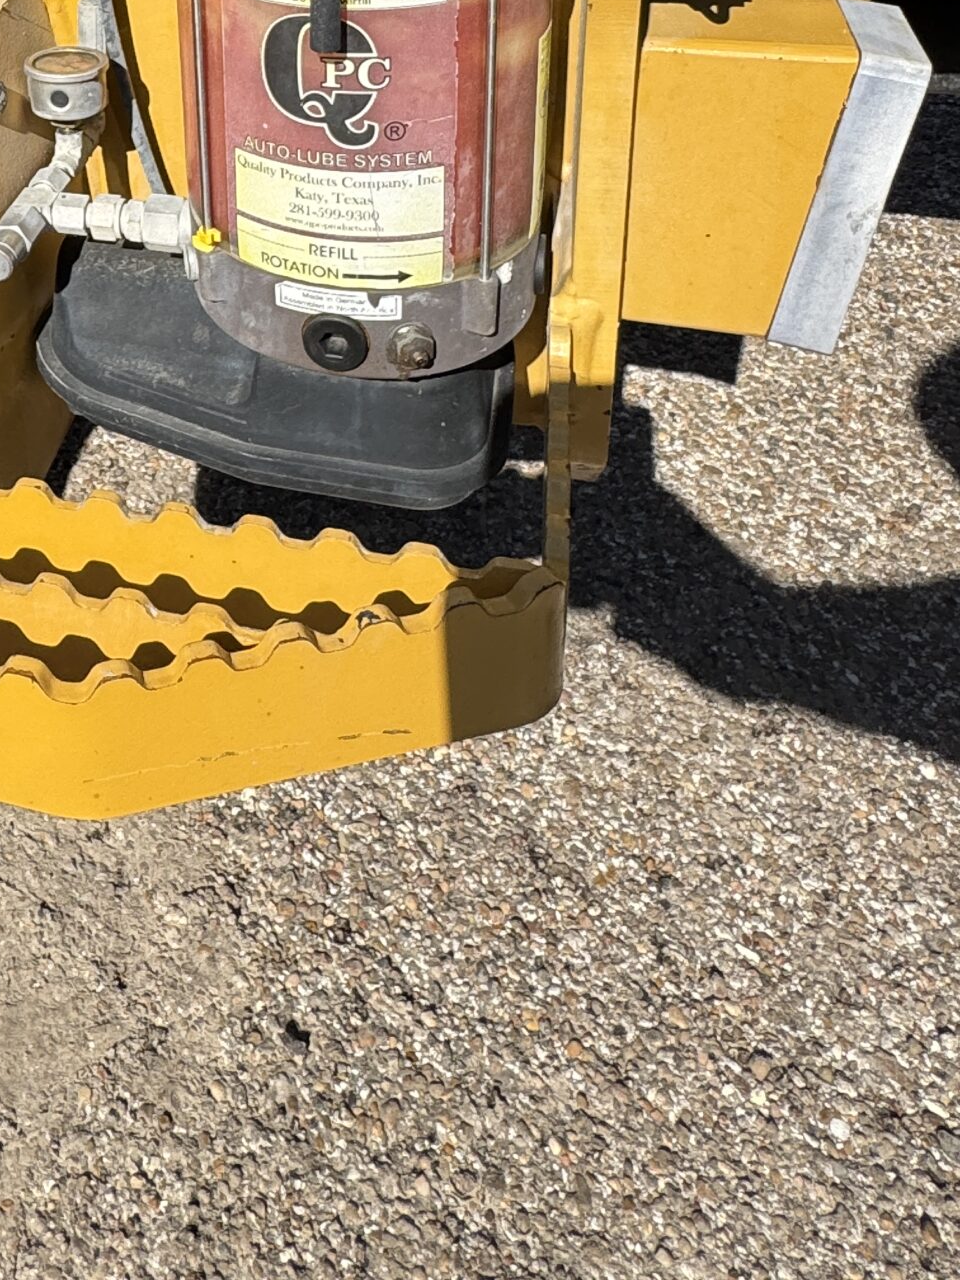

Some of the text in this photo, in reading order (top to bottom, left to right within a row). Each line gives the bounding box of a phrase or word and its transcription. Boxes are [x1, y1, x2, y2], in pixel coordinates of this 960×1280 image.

[244, 135, 433, 168] AUTO-LUBE SYSTEM
[237, 153, 442, 192] Quality Products Company, Inc.
[295, 186, 374, 206] Katy, Texas
[288, 201, 380, 221] 281-599-9300
[308, 243, 359, 261] REFILL
[261, 251, 339, 280] ROTATION
